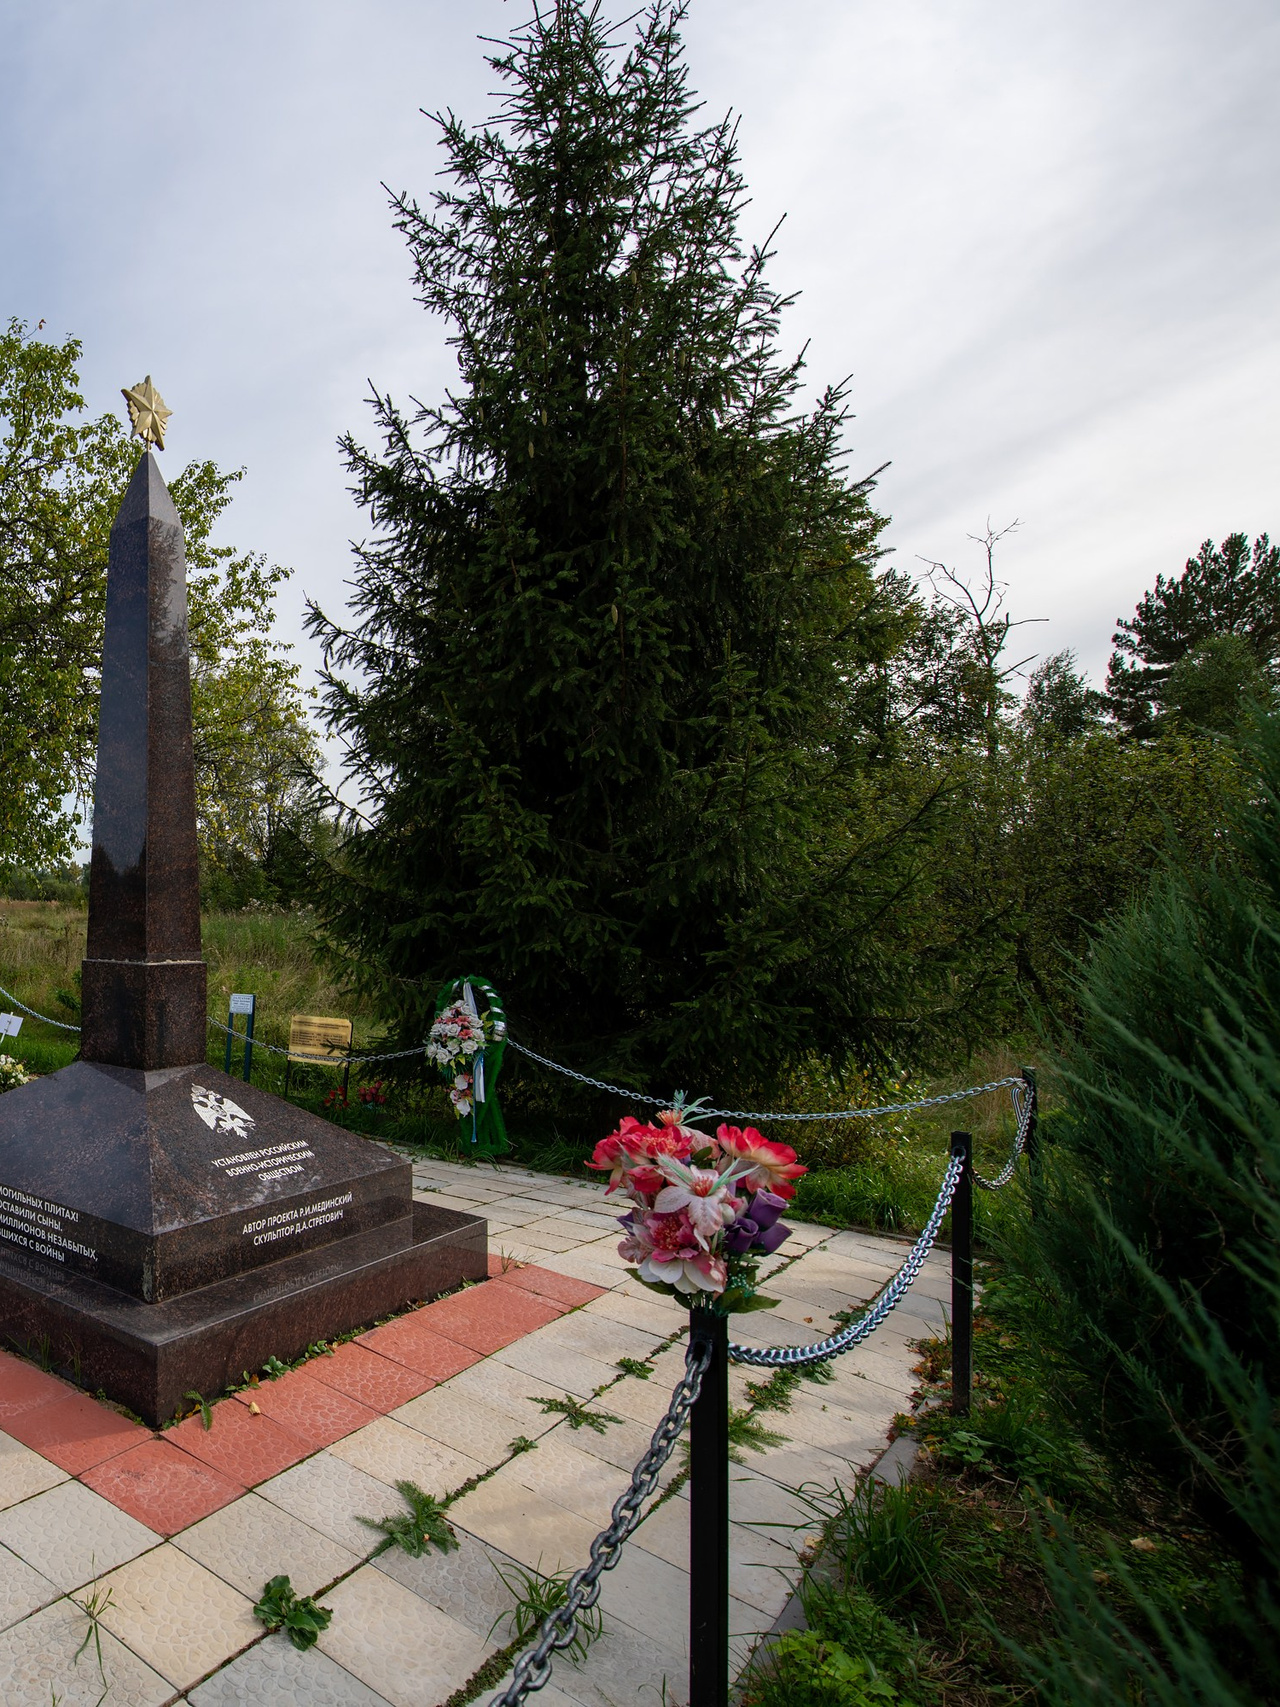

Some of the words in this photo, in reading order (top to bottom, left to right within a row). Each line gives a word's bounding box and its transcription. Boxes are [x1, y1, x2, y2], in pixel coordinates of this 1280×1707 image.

[211, 1150, 261, 1168] УСТАНОВЛЕН
[259, 1139, 310, 1158] РОССИЙСКИМ
[225, 1149, 315, 1177] ВОЕННО-ИСТОРИЧЕСКИМ
[258, 1164, 305, 1181] ОБЩЕСТВОМ
[36, 1213, 63, 1232] СЫНЫ.
[44, 1201, 80, 1223] ПЛИТАХ!
[242, 1218, 267, 1235] АВТОР
[267, 1209, 299, 1227] ПРОЕКТА
[299, 1191, 354, 1219] Р.И.МЕДИНСКИЙ
[253, 1223, 295, 1247] СКУЛЬПТОР
[295, 1209, 344, 1235] Д.А.СТРЕТОВИЧ
[28, 1239, 35, 1250] С
[35, 1240, 65, 1262] ВОЙНЫ
[47, 1232, 99, 1262] НЕЗАБЫТЫХ,
